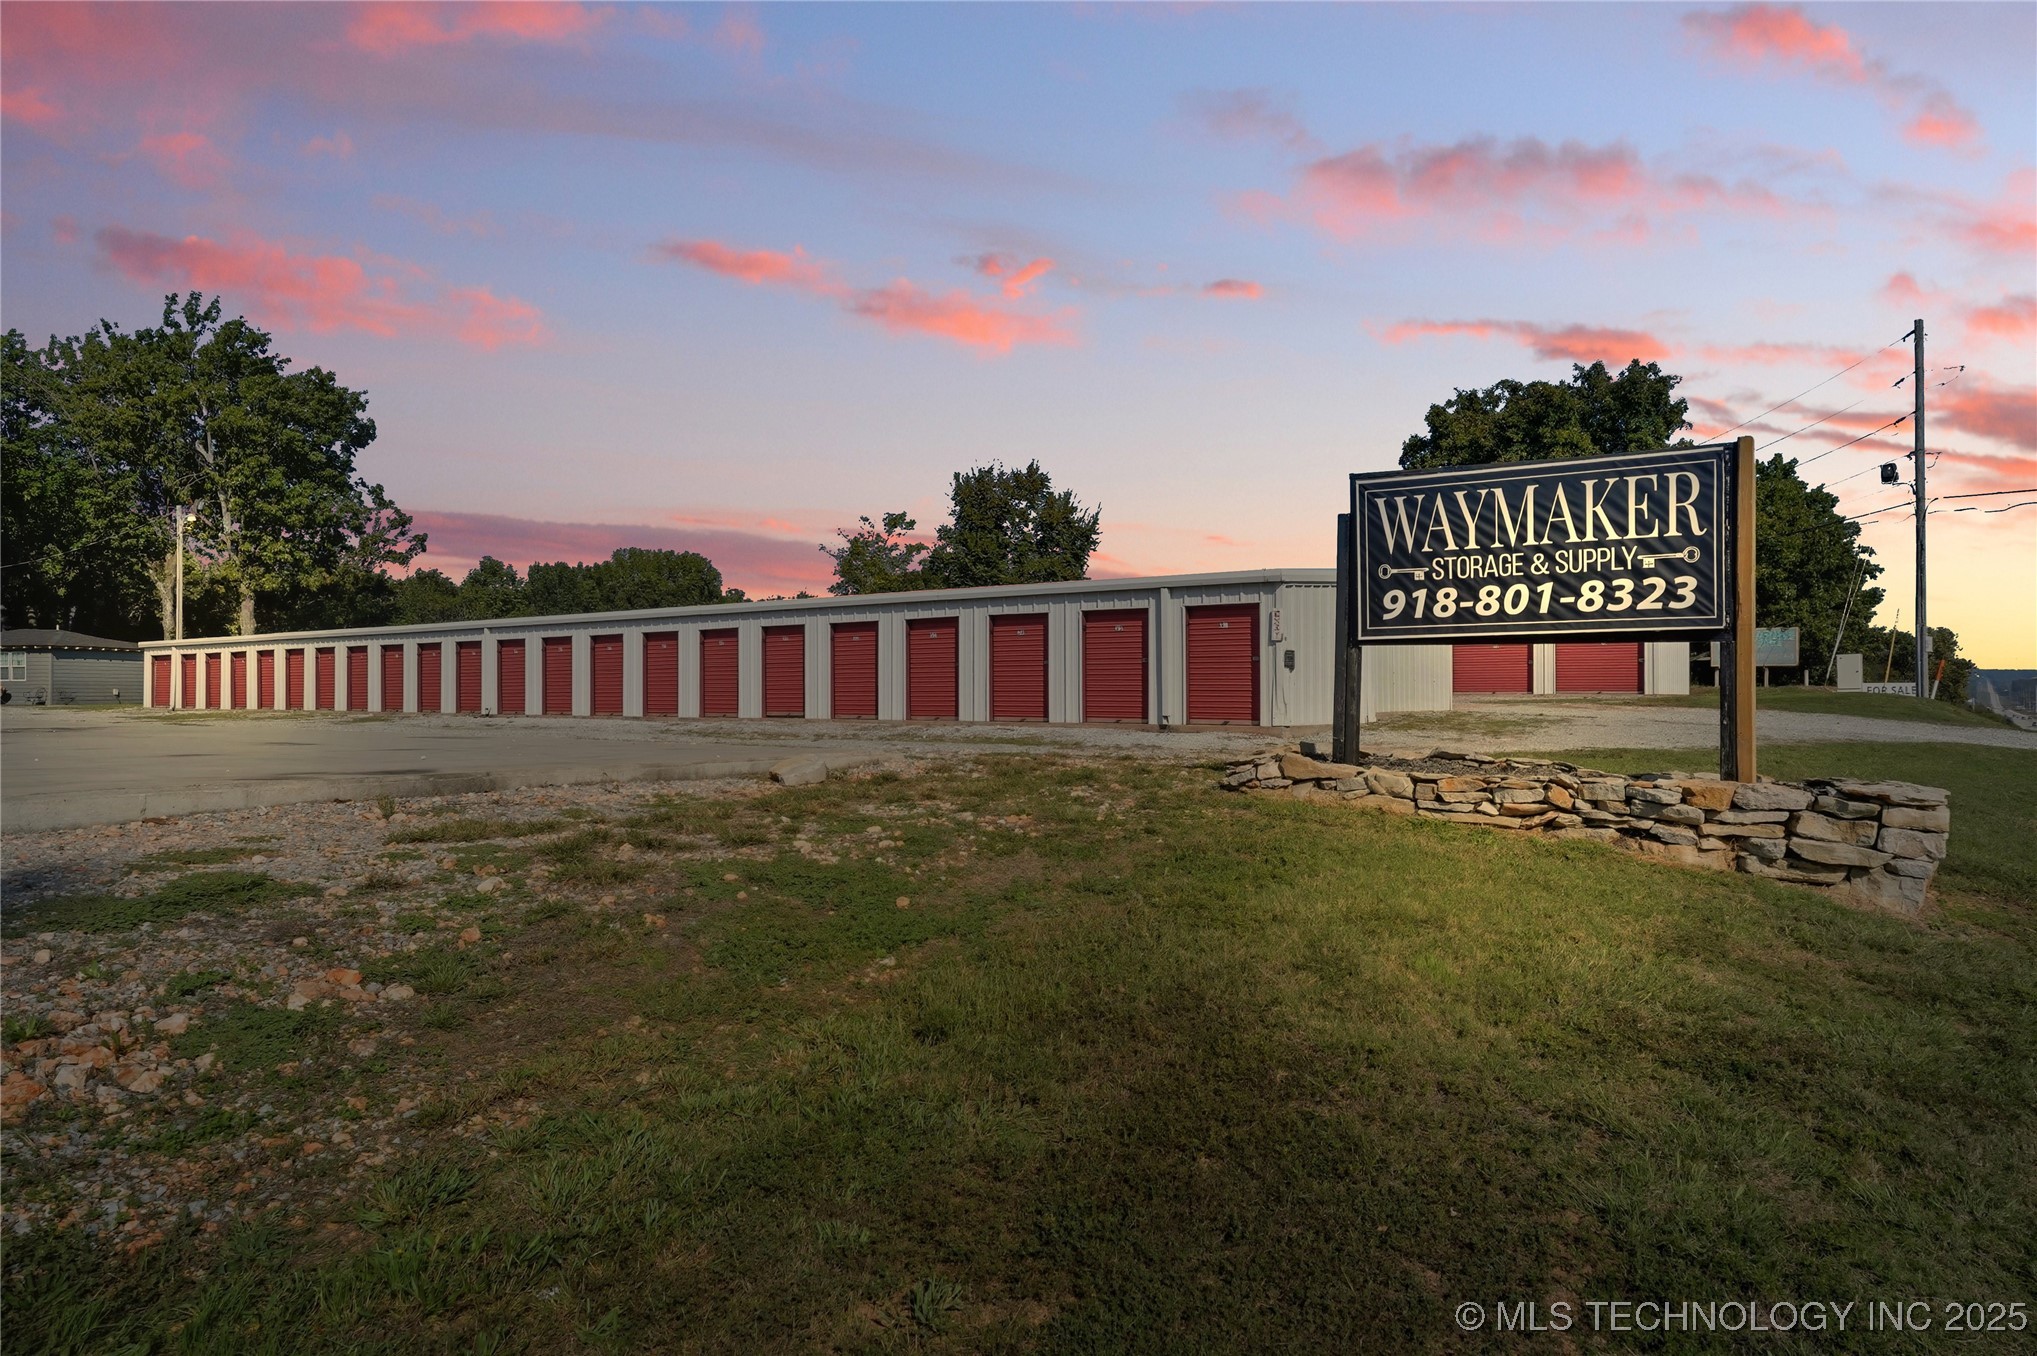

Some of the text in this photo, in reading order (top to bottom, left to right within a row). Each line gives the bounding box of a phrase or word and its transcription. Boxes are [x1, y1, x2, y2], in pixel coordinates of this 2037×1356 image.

[1374, 471, 1708, 555] WAYMAKER
[1431, 545, 1638, 581] STORAGE & SUPPLY
[1382, 575, 1699, 621] 918-801-8323
[1866, 686, 1917, 696] FOR SALE
